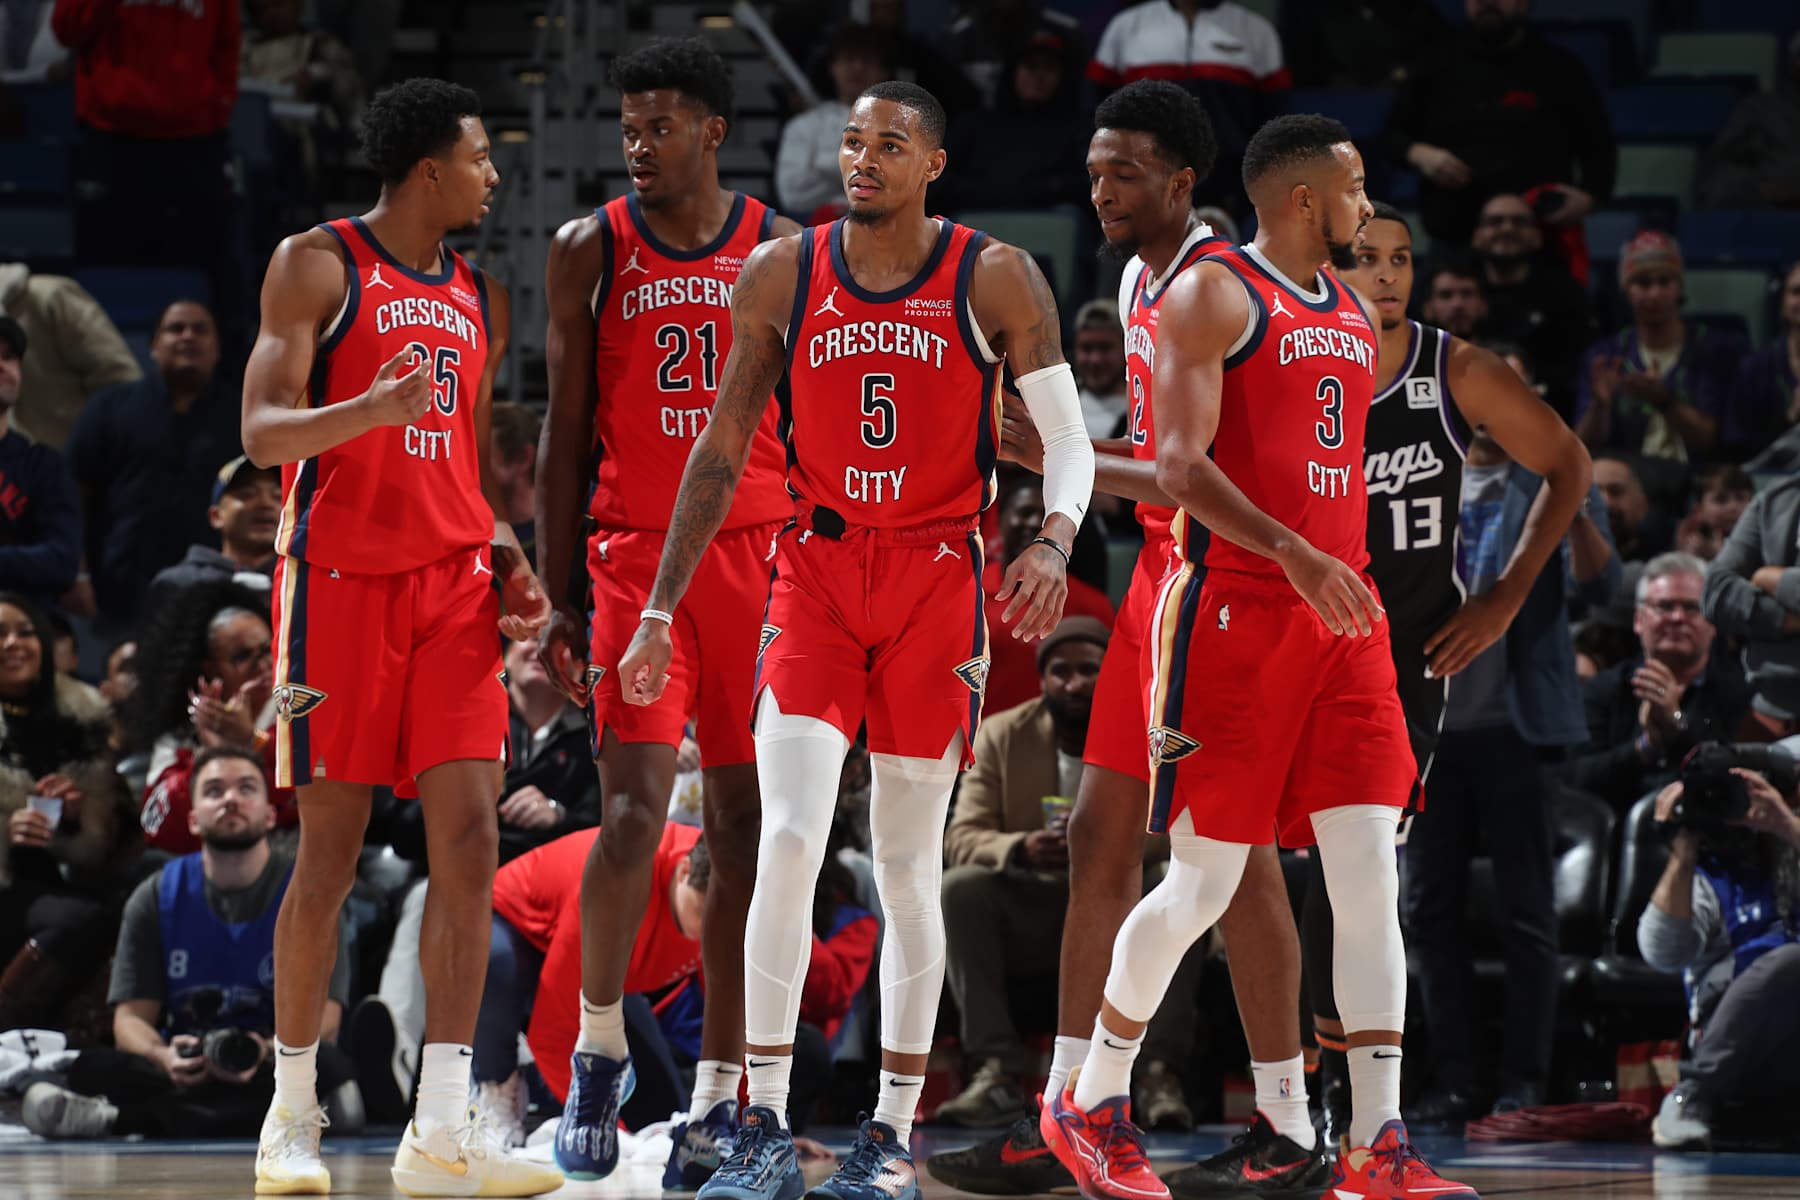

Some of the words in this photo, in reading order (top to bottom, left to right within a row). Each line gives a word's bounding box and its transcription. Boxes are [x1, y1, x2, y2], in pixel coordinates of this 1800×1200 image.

[714, 256, 746, 265] NEWA
[622, 276, 734, 320] CRESCEN
[904, 310, 953, 318] PRODUCTS
[905, 298, 953, 310] NEWAGE
[376, 298, 478, 351] CRESCENT
[809, 320, 949, 369] CRESCENT
[655, 321, 719, 392] 21
[1279, 326, 1374, 376] CRESCENT
[861, 373, 897, 449] 5
[1132, 374, 1148, 447] 2
[1316, 375, 1345, 450] 3
[1414, 382, 1431, 397] R
[404, 424, 452, 461] CITY
[845, 465, 907, 504] CITY
[1307, 460, 1351, 499] CITY
[1363, 441, 1444, 495] ngs
[1388, 496, 1443, 551] 13
[168, 949, 189, 979] 8
